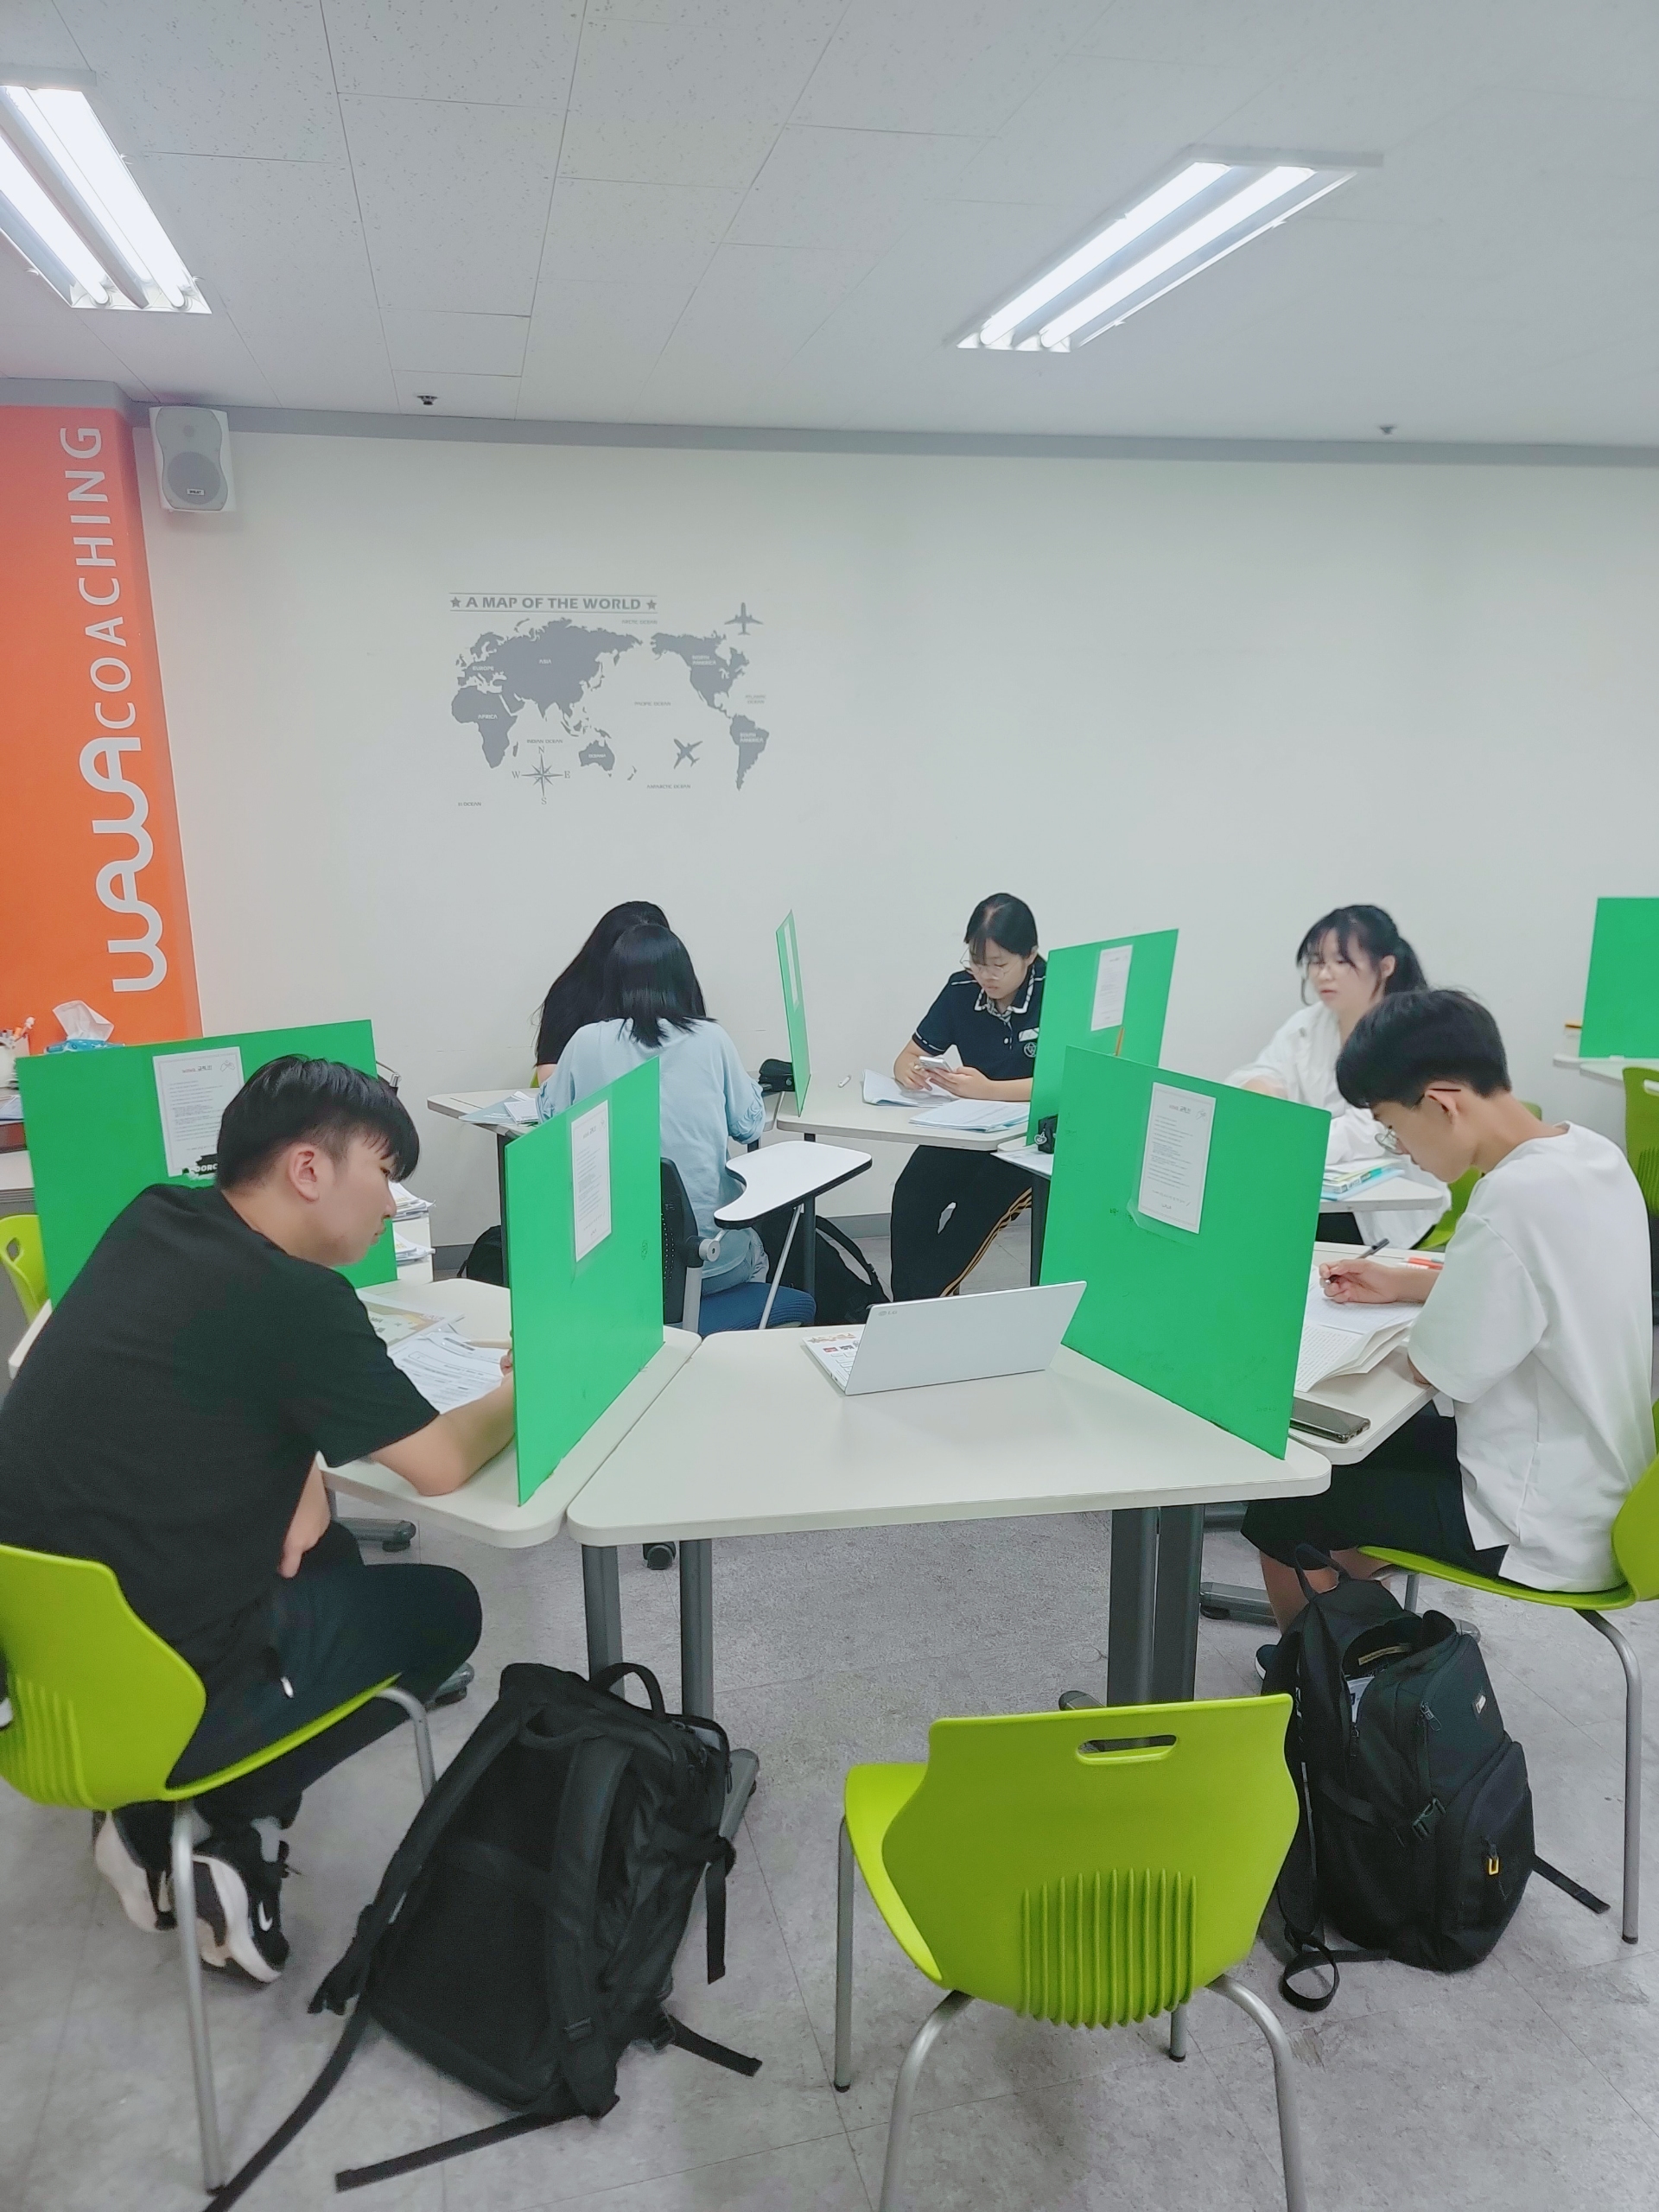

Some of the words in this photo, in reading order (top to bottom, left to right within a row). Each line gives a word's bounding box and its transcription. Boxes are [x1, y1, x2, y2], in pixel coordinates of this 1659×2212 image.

[60, 427, 137, 730] COACHING
[465, 597, 479, 608] A
[482, 597, 518, 609] MAP
[522, 597, 544, 609] OF
[547, 598, 578, 610] THE
[582, 598, 641, 610] WORLD
[537, 746, 545, 754] N
[512, 771, 520, 779] W
[541, 797, 548, 805] S
